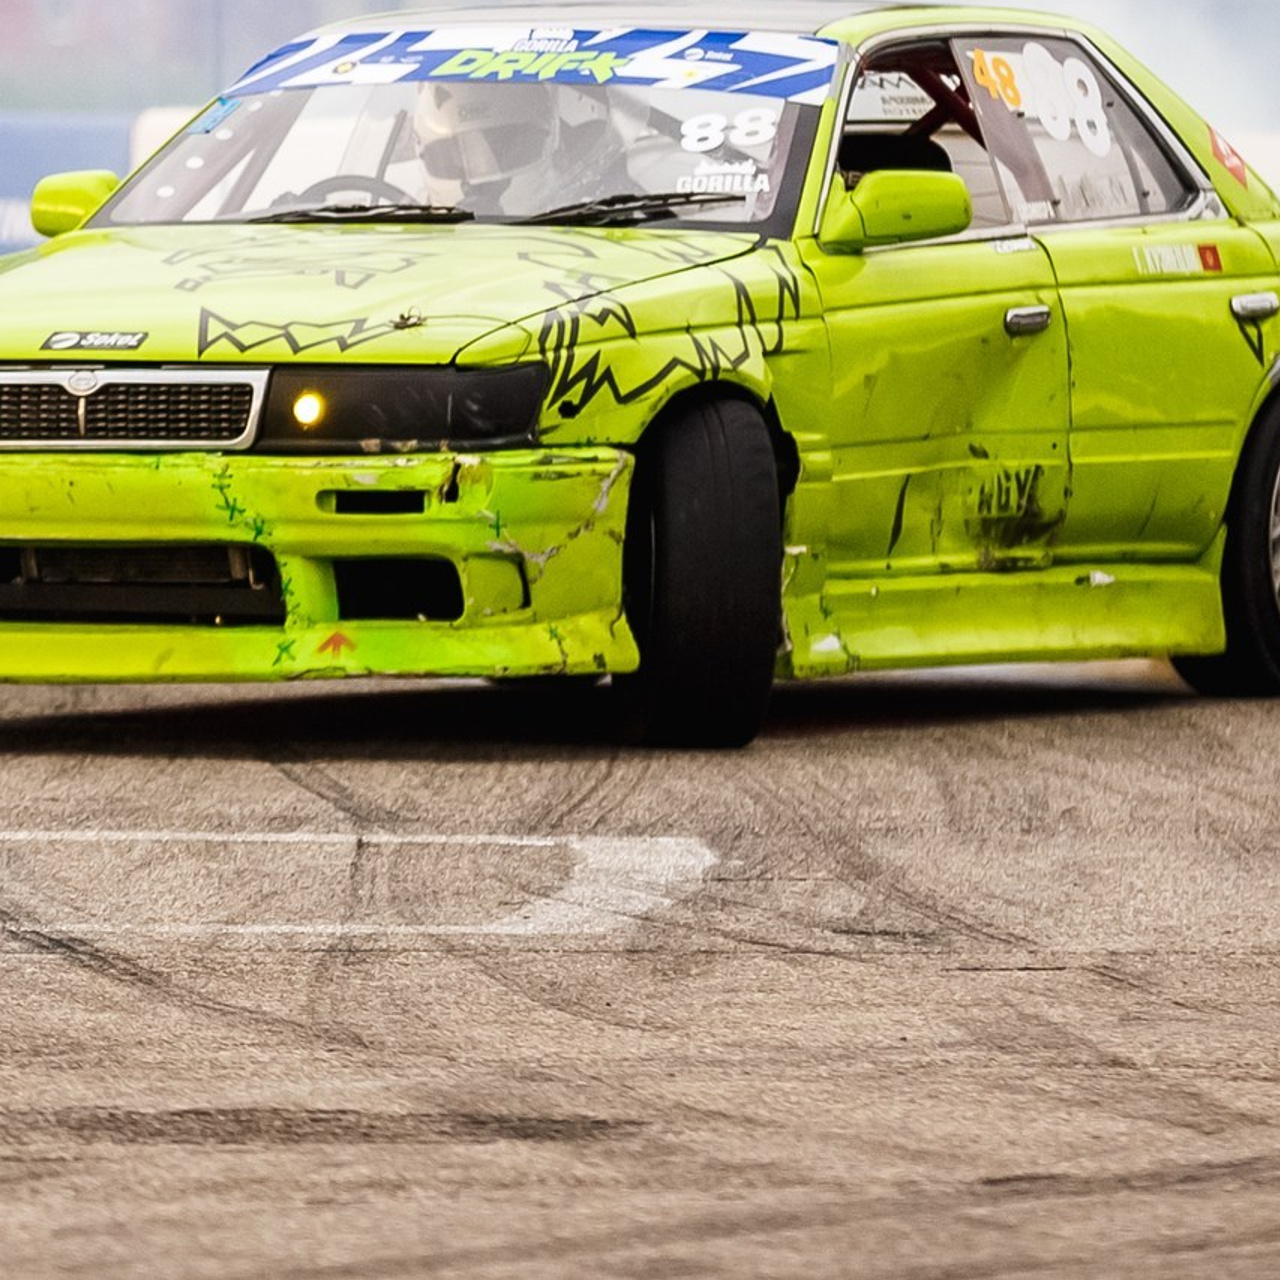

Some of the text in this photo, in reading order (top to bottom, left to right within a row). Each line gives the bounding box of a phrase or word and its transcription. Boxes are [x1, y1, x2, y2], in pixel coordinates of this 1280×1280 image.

[428, 47, 634, 84] DRIFT
[973, 48, 1021, 107] 48
[680, 107, 778, 152] 88
[676, 173, 770, 194] GORILLA
